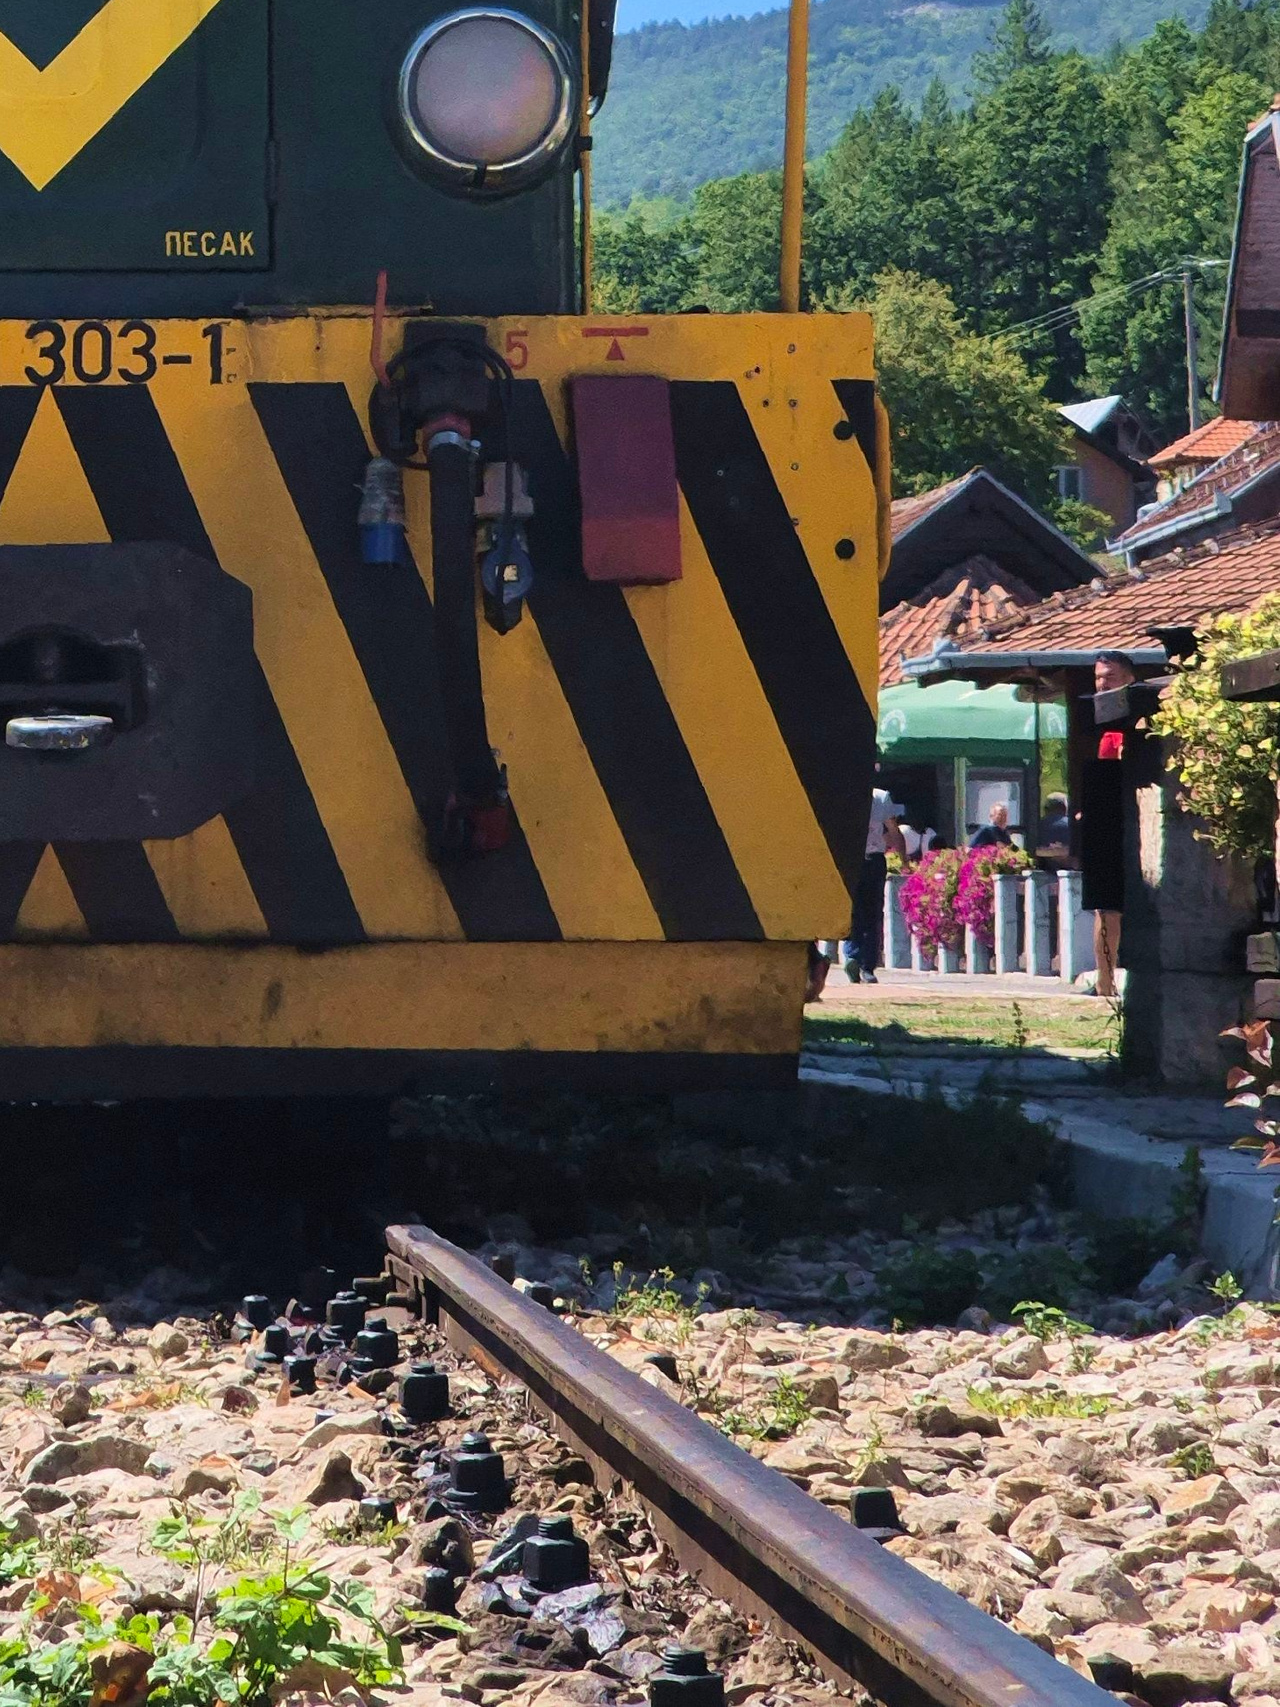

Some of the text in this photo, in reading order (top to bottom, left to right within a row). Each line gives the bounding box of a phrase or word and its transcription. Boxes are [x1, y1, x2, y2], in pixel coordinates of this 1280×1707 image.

[165, 230, 255, 256] ПЕСАК
[23, 321, 223, 385] 303-1
[505, 329, 529, 371] 5
